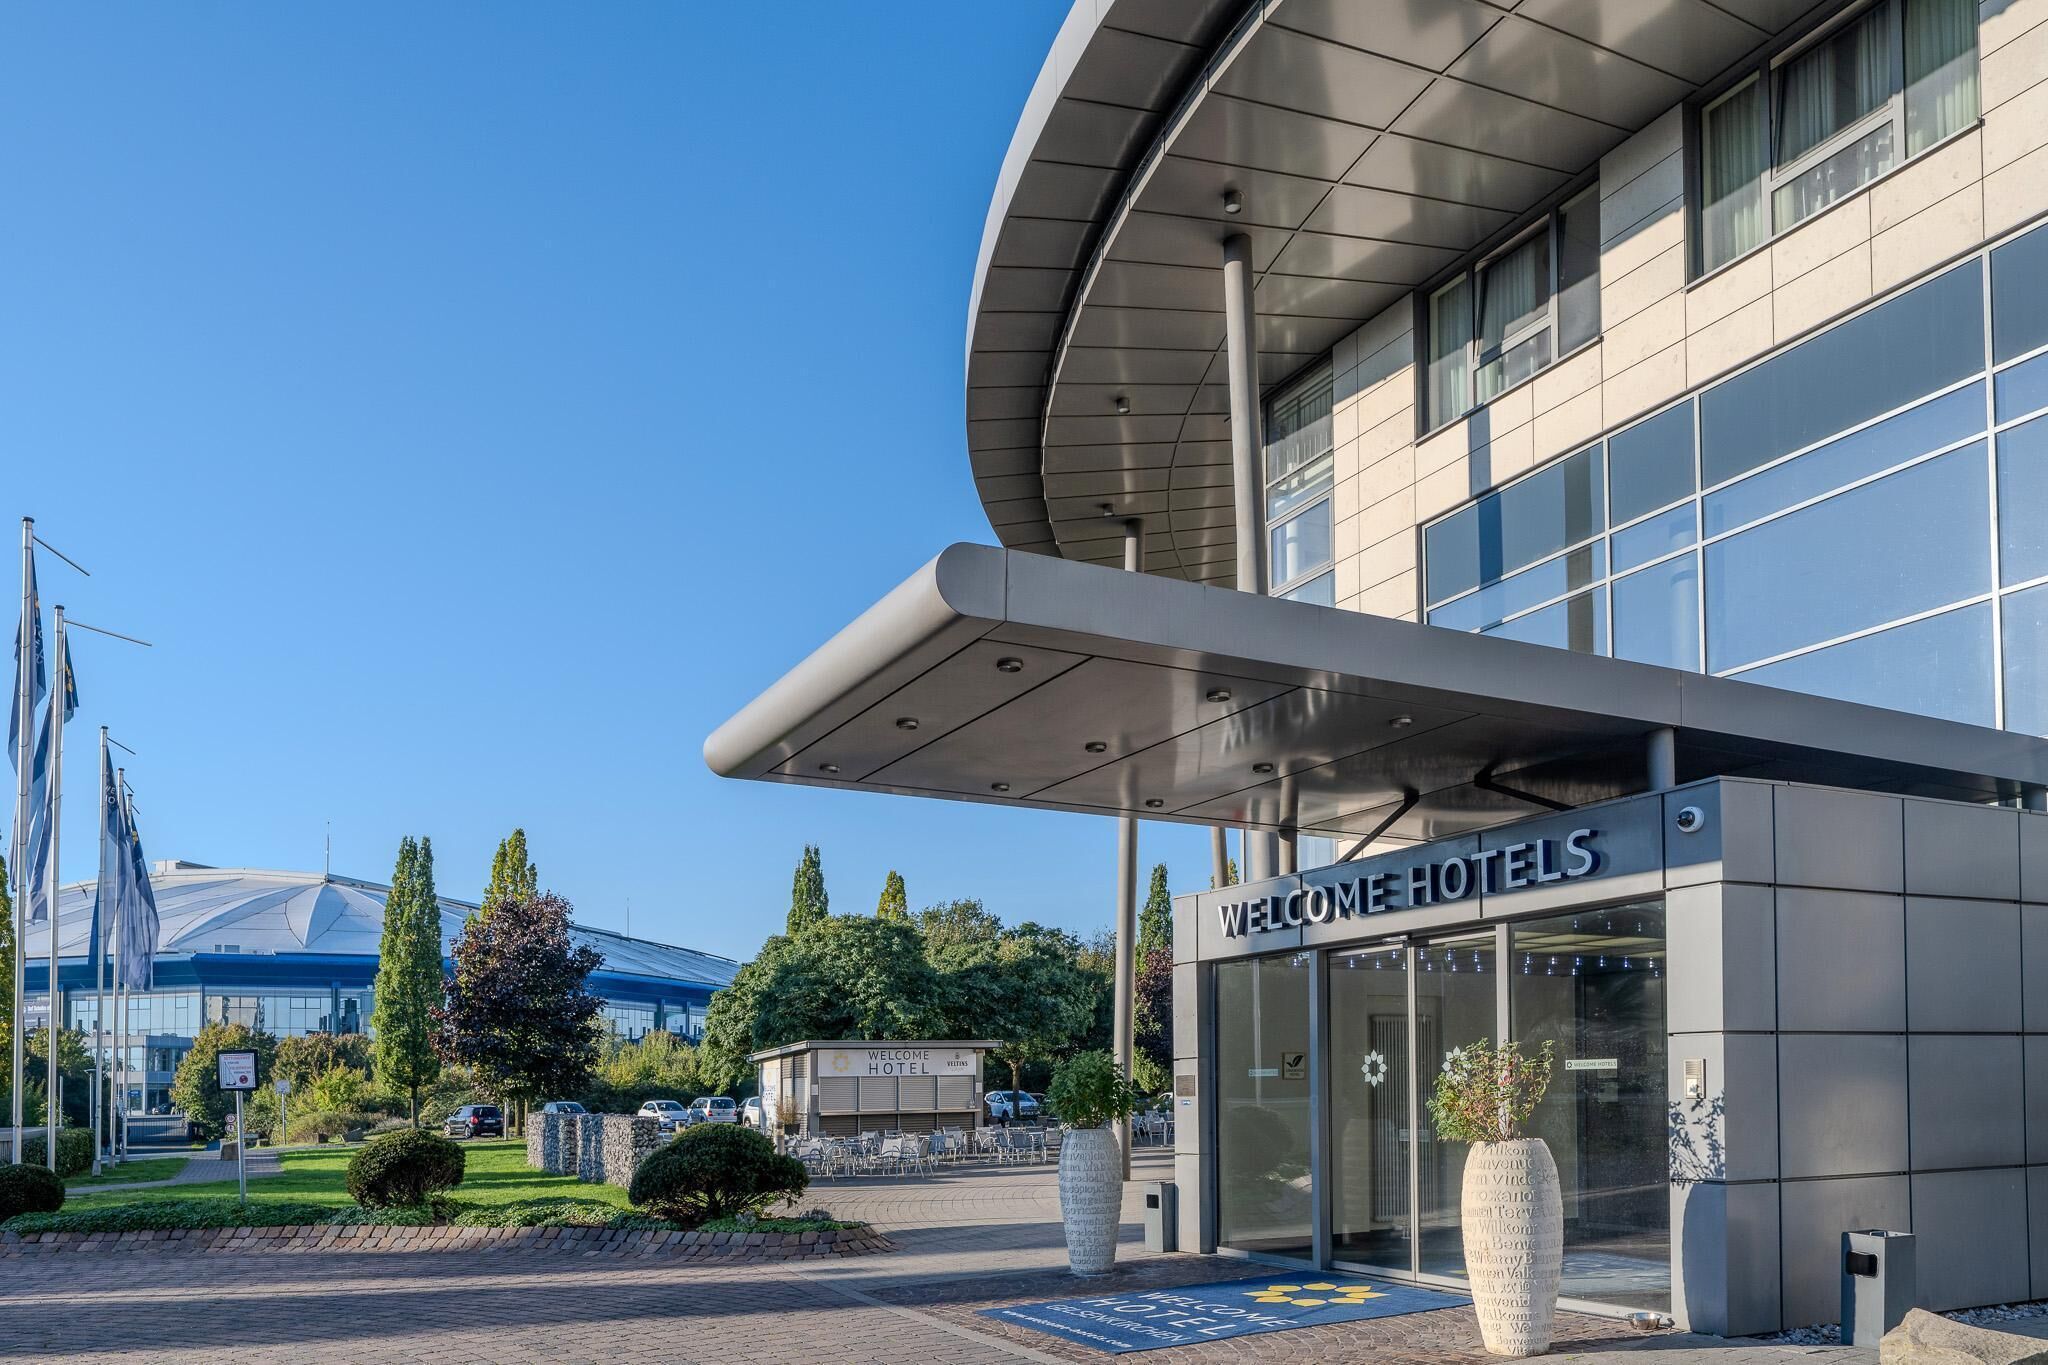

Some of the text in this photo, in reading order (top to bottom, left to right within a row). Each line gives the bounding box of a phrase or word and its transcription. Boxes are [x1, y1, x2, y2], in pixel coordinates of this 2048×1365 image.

[1217, 828, 1593, 939] WELCOME HOTELS
[868, 1050, 929, 1060] WELCOME
[868, 1062, 930, 1075] HOTEL
[1046, 1304, 1192, 1342] GELSENKIRCHEN
[1081, 1298, 1236, 1336] HOTEL
[1138, 1292, 1298, 1327] WELCOME
